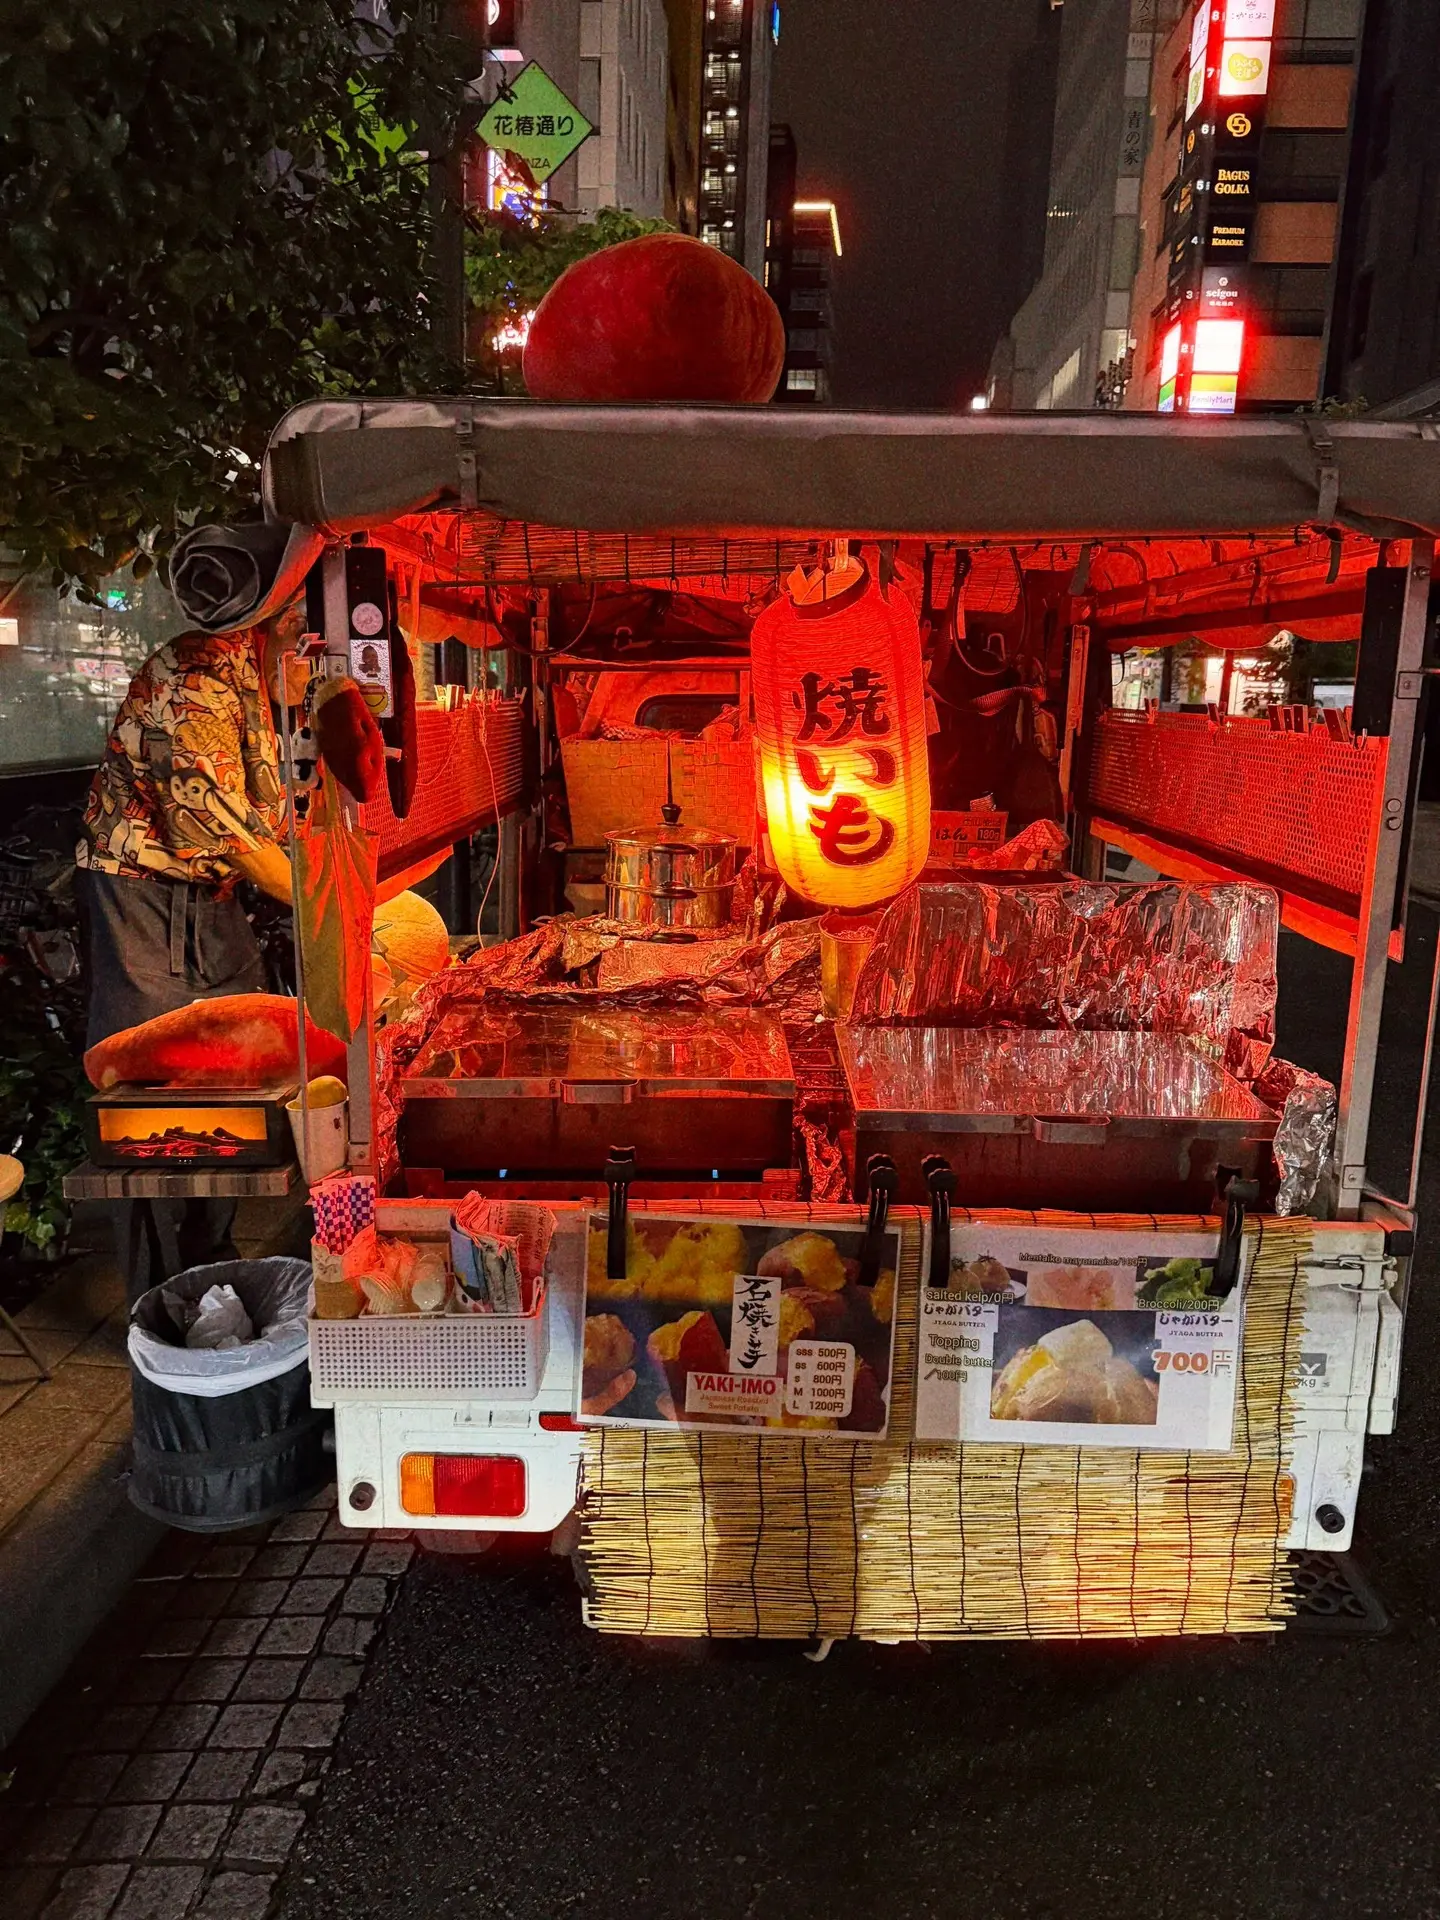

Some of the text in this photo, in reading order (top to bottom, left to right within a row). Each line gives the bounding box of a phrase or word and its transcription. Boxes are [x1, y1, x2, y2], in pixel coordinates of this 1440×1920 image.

[494, 115, 574, 136] 花椿通り
[1201, 124, 1209, 134] 6
[526, 158, 551, 169] NZA
[1218, 169, 1250, 181] BAGUS
[1196, 179, 1205, 190] 5
[1214, 183, 1250, 195] GOLKA
[1213, 226, 1245, 235] PREMIUM
[1212, 238, 1244, 247] KARAOKE
[791, 667, 897, 866] 焼いも
[924, 1303, 995, 1317] じゃがバター
[1138, 1298, 1220, 1311] Broccoli/200円
[1160, 1313, 1233, 1327] じゃがバター
[928, 1333, 980, 1351] Topping
[818, 1348, 846, 1359] 500円
[924, 1354, 996, 1368] Double butter
[1152, 1349, 1233, 1377] 700円
[816, 1362, 846, 1372] 600円
[694, 1374, 777, 1396] YAKI-IMO
[813, 1375, 842, 1385] 800円
[700, 1394, 735, 1402] Japanese
[793, 1388, 846, 1399] M 1000円
[708, 1403, 760, 1412] Sweet Potato
[809, 1401, 844, 1412] 1200円
